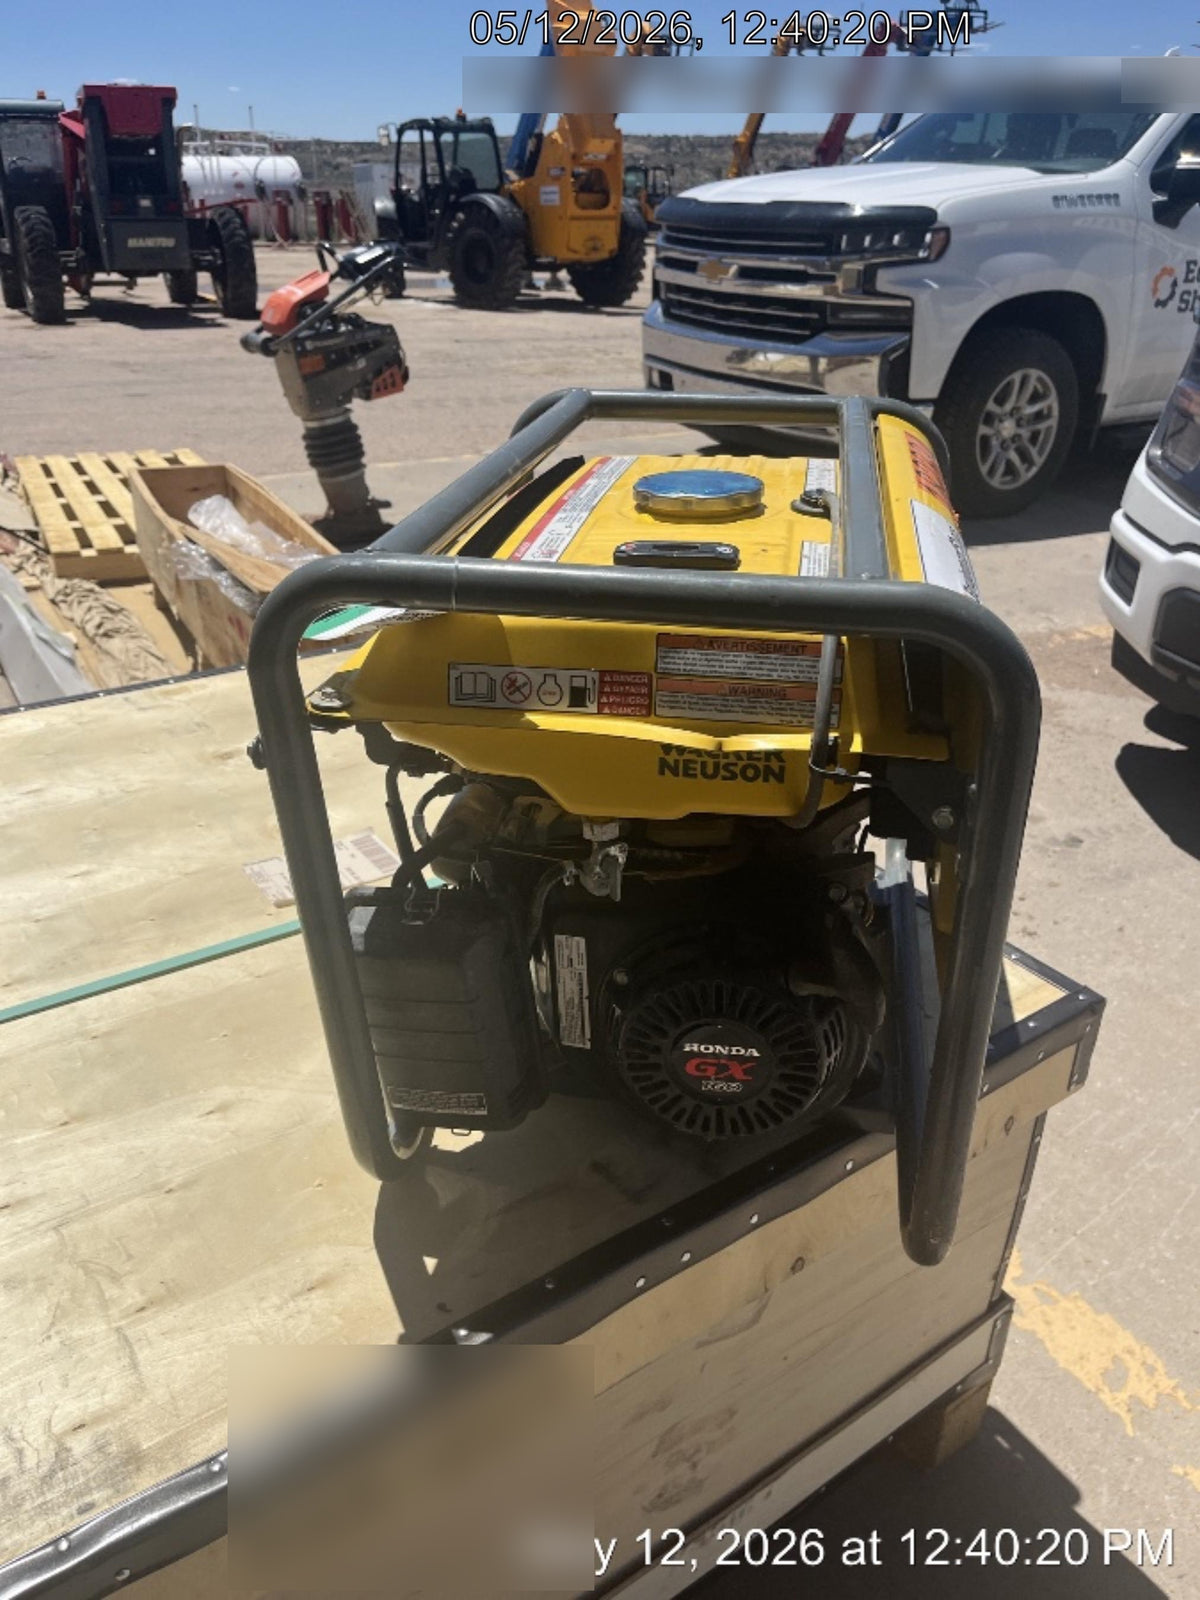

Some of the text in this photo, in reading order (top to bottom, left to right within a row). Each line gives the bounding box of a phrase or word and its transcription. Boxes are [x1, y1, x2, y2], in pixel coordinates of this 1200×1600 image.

[707, 639, 808, 655] AVERTISSEMENT
[612, 673, 648, 684] DANGER
[728, 685, 787, 699] WARNING
[609, 695, 650, 705] PELIGRO
[658, 757, 786, 783] NEUSON
[683, 1043, 760, 1056] HONDA
[685, 1057, 756, 1080] GX
